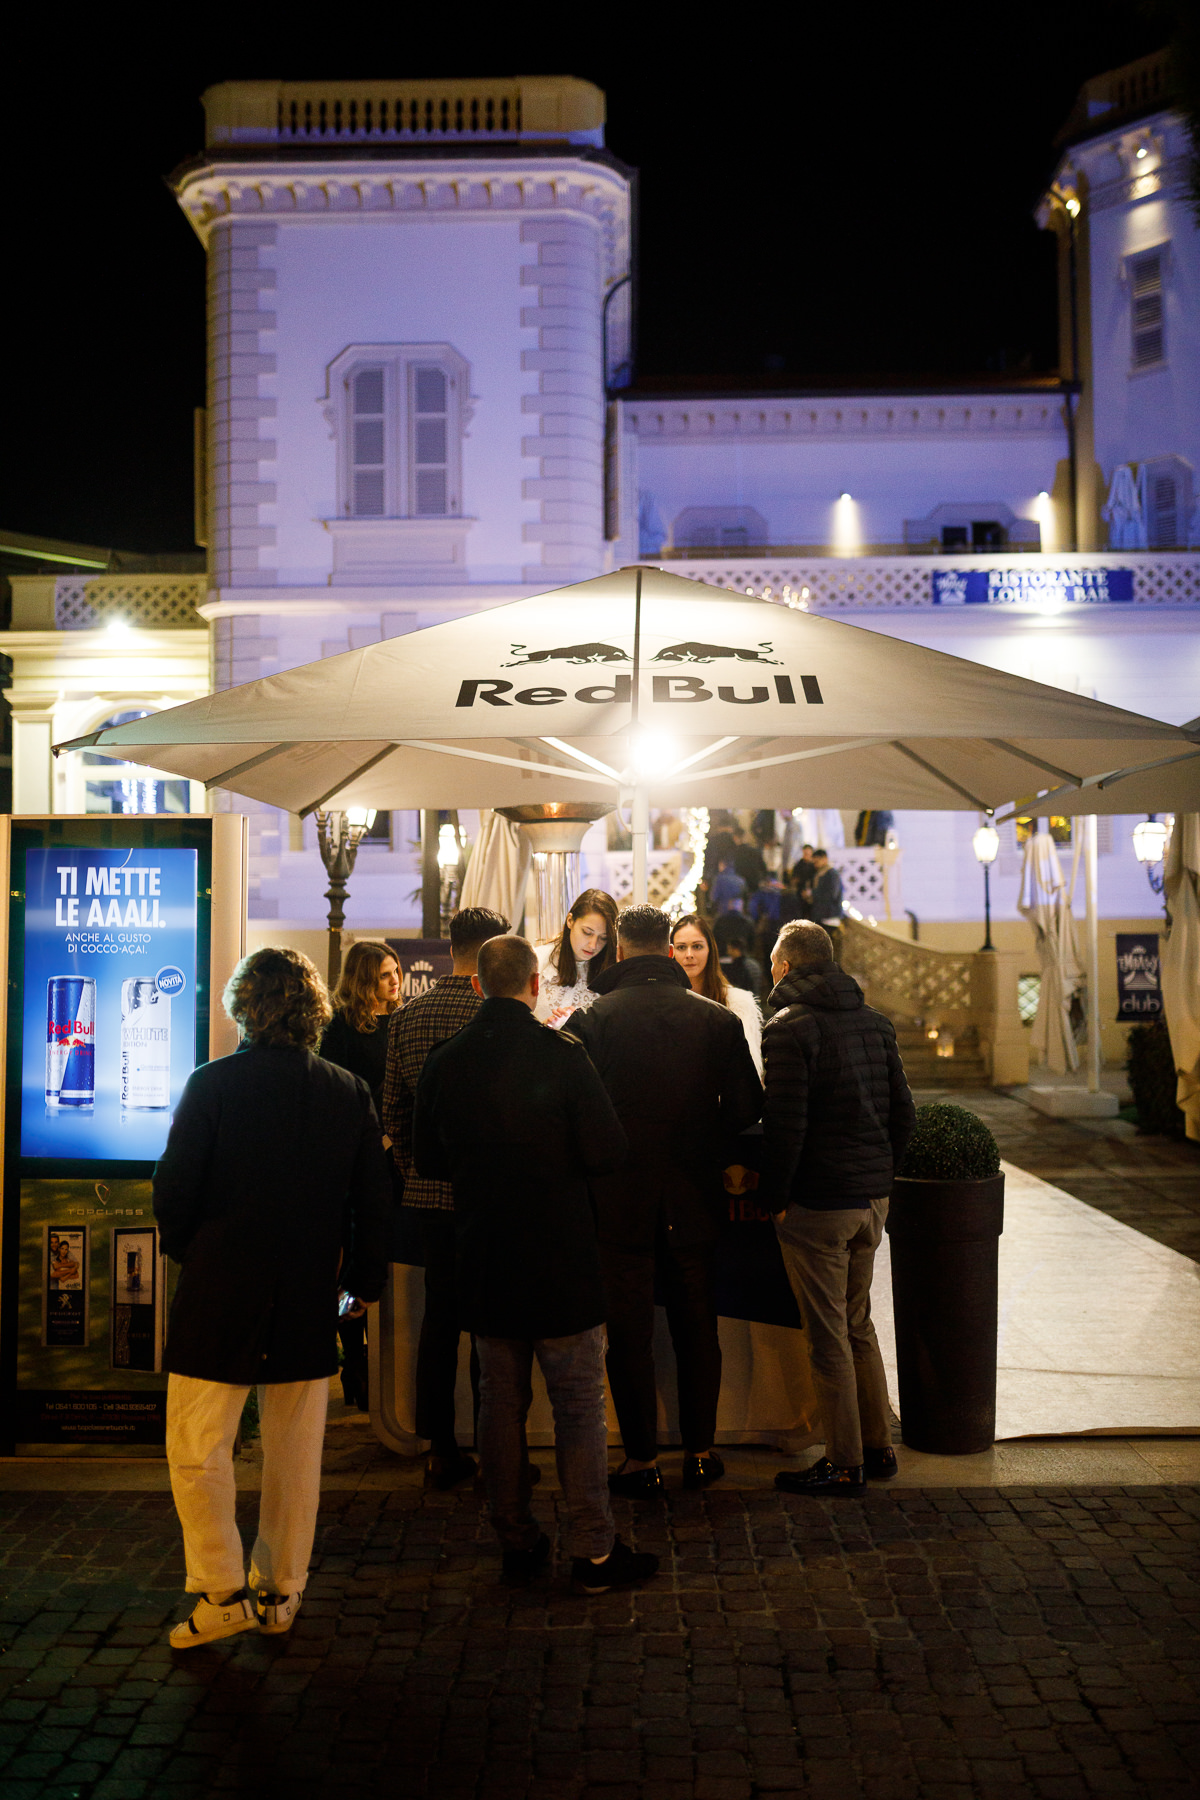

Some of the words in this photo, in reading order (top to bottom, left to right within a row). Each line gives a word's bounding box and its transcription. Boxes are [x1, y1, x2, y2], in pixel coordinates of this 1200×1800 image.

[989, 570, 1108, 587] RISTORANTE
[1074, 586, 1109, 603] BAR
[455, 675, 631, 707] Red
[652, 675, 824, 704] Bull
[57, 866, 78, 895] TI
[85, 866, 161, 896] METTE
[55, 898, 79, 927] LE
[86, 898, 166, 928] AAALI.
[65, 932, 100, 943] ANCHE
[103, 933, 115, 943] AL
[117, 933, 152, 943] GUSTO
[68, 944, 78, 954] DI
[49, 1019, 71, 1035] Red
[74, 1020, 95, 1035] Bull
[122, 1027, 169, 1041] WHITE
[121, 1076, 129, 1101] Red
[67, 1208, 144, 1216] TOPCLASS
